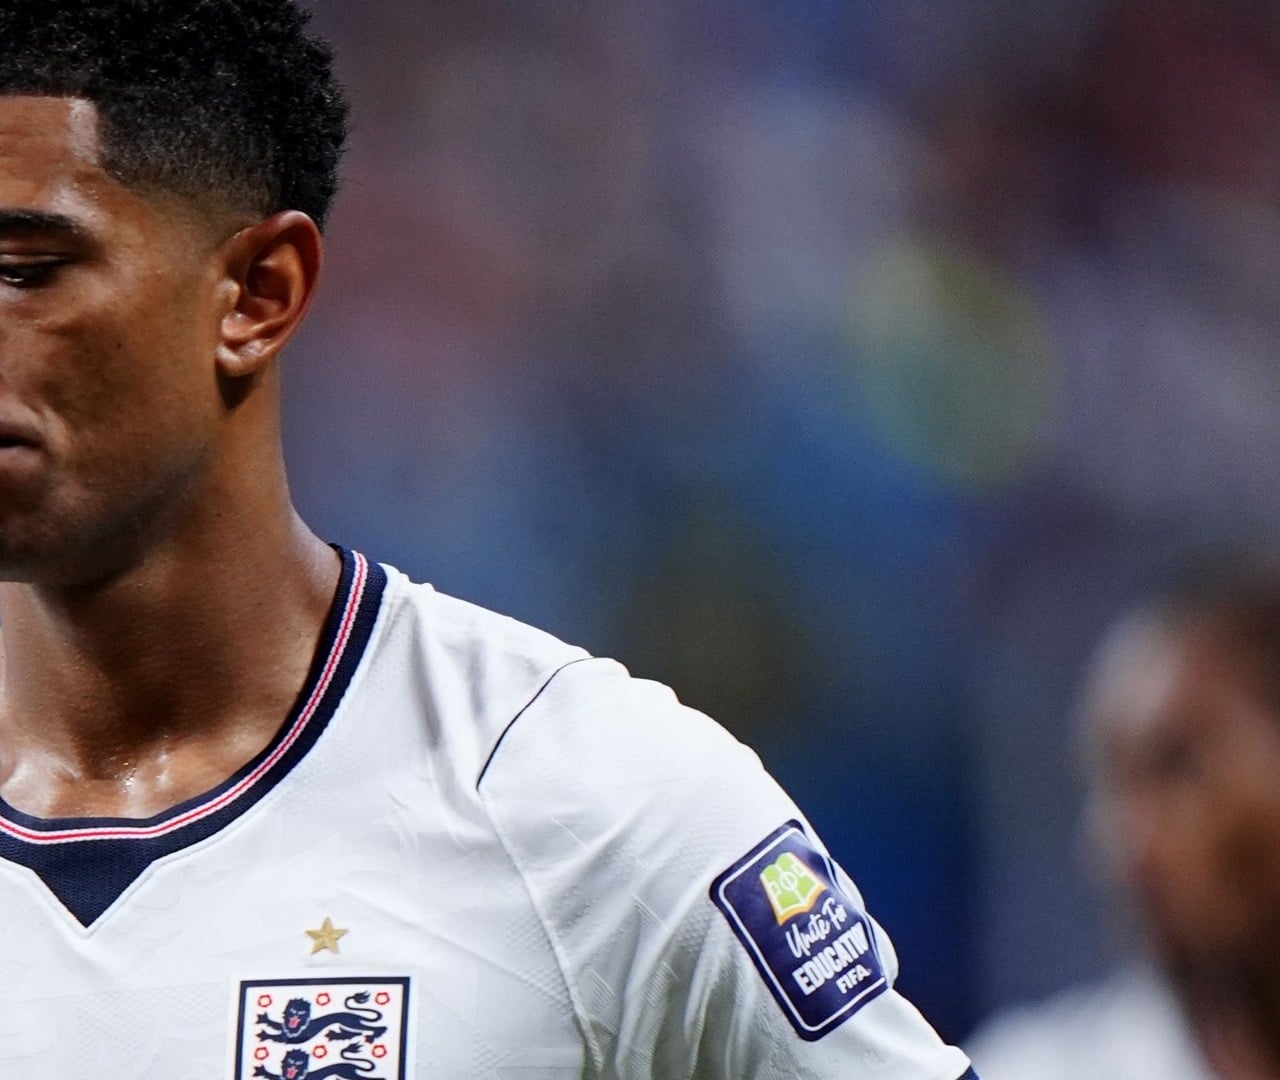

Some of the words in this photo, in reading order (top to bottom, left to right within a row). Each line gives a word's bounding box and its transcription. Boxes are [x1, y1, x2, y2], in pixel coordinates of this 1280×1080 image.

[785, 914, 830, 958] Unite
[821, 897, 847, 930] For
[836, 964, 871, 994] FIFA
